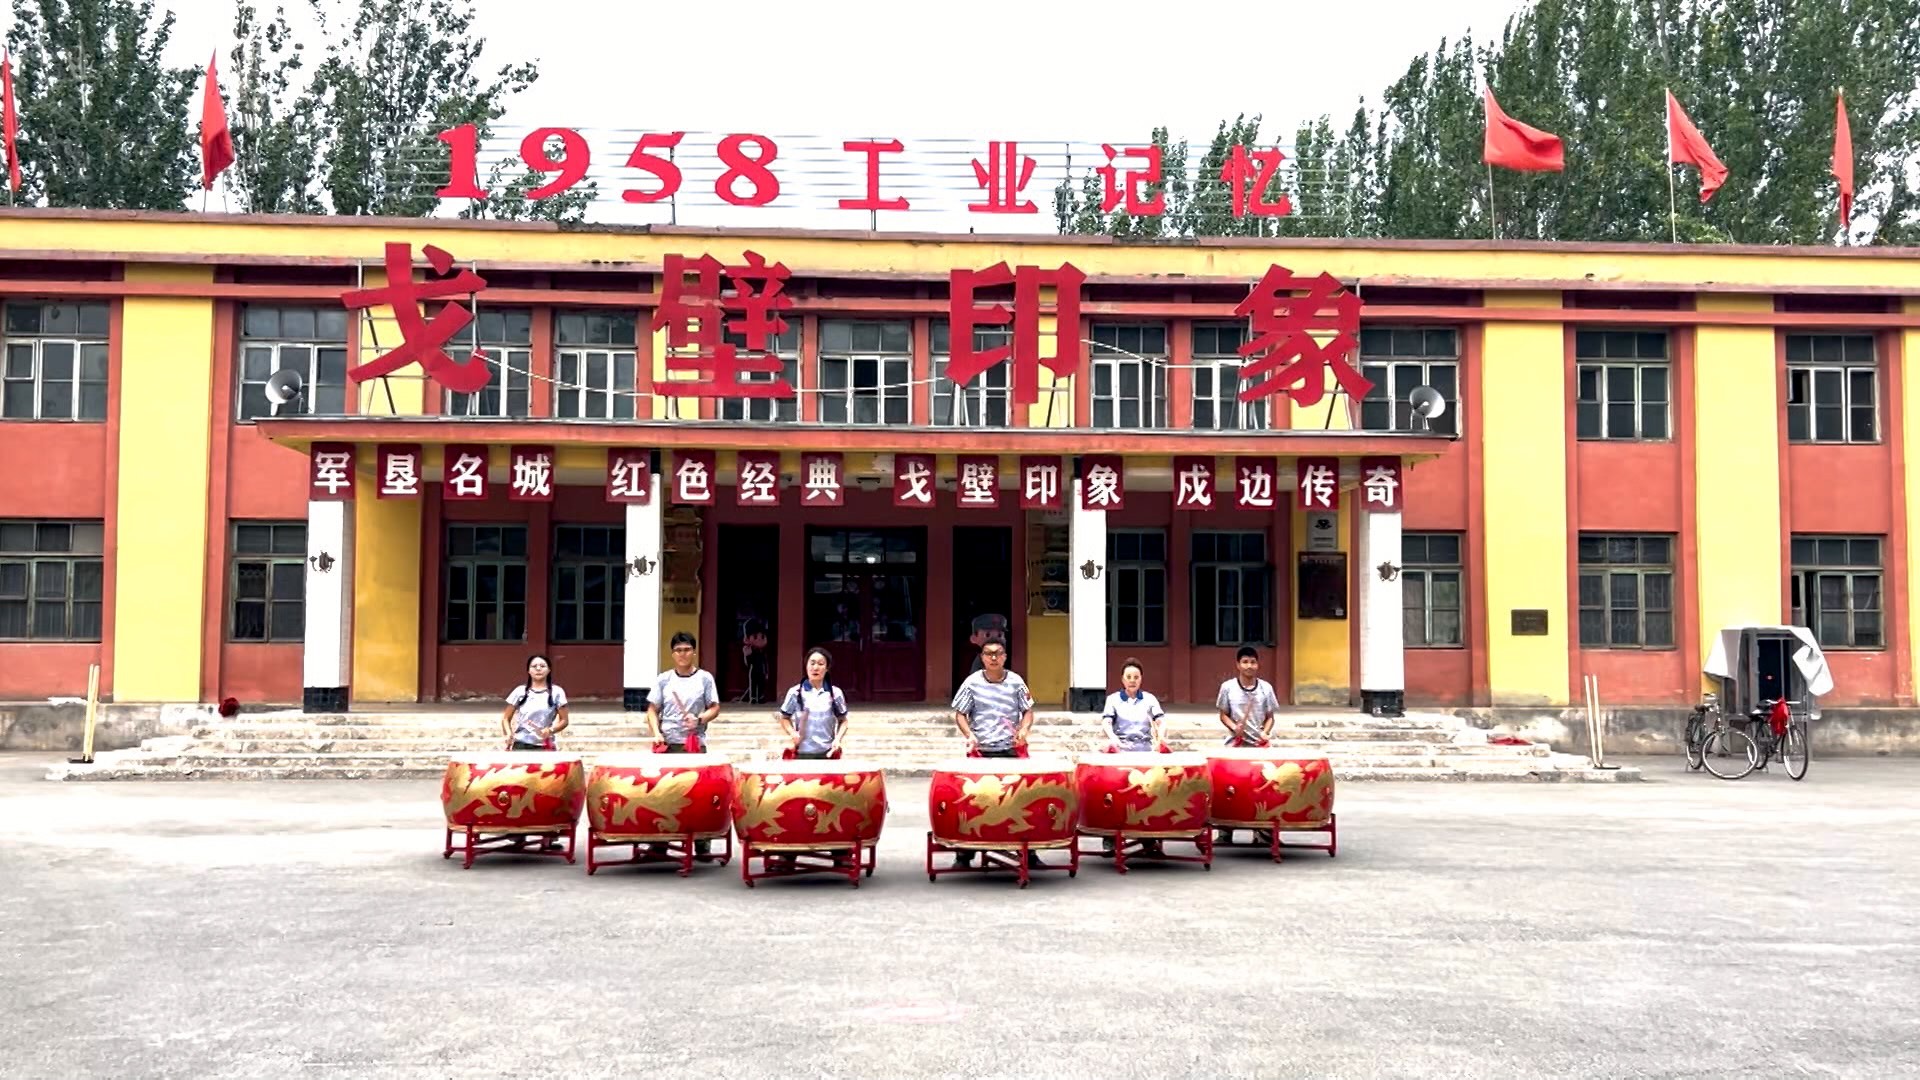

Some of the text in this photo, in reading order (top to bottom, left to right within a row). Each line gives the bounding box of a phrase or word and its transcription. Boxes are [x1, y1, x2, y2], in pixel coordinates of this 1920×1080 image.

[341, 242, 1375, 408] 戈壁印象
[313, 452, 1399, 508] 军垦名城 红色经典 戈壁印象 戍边传奇
